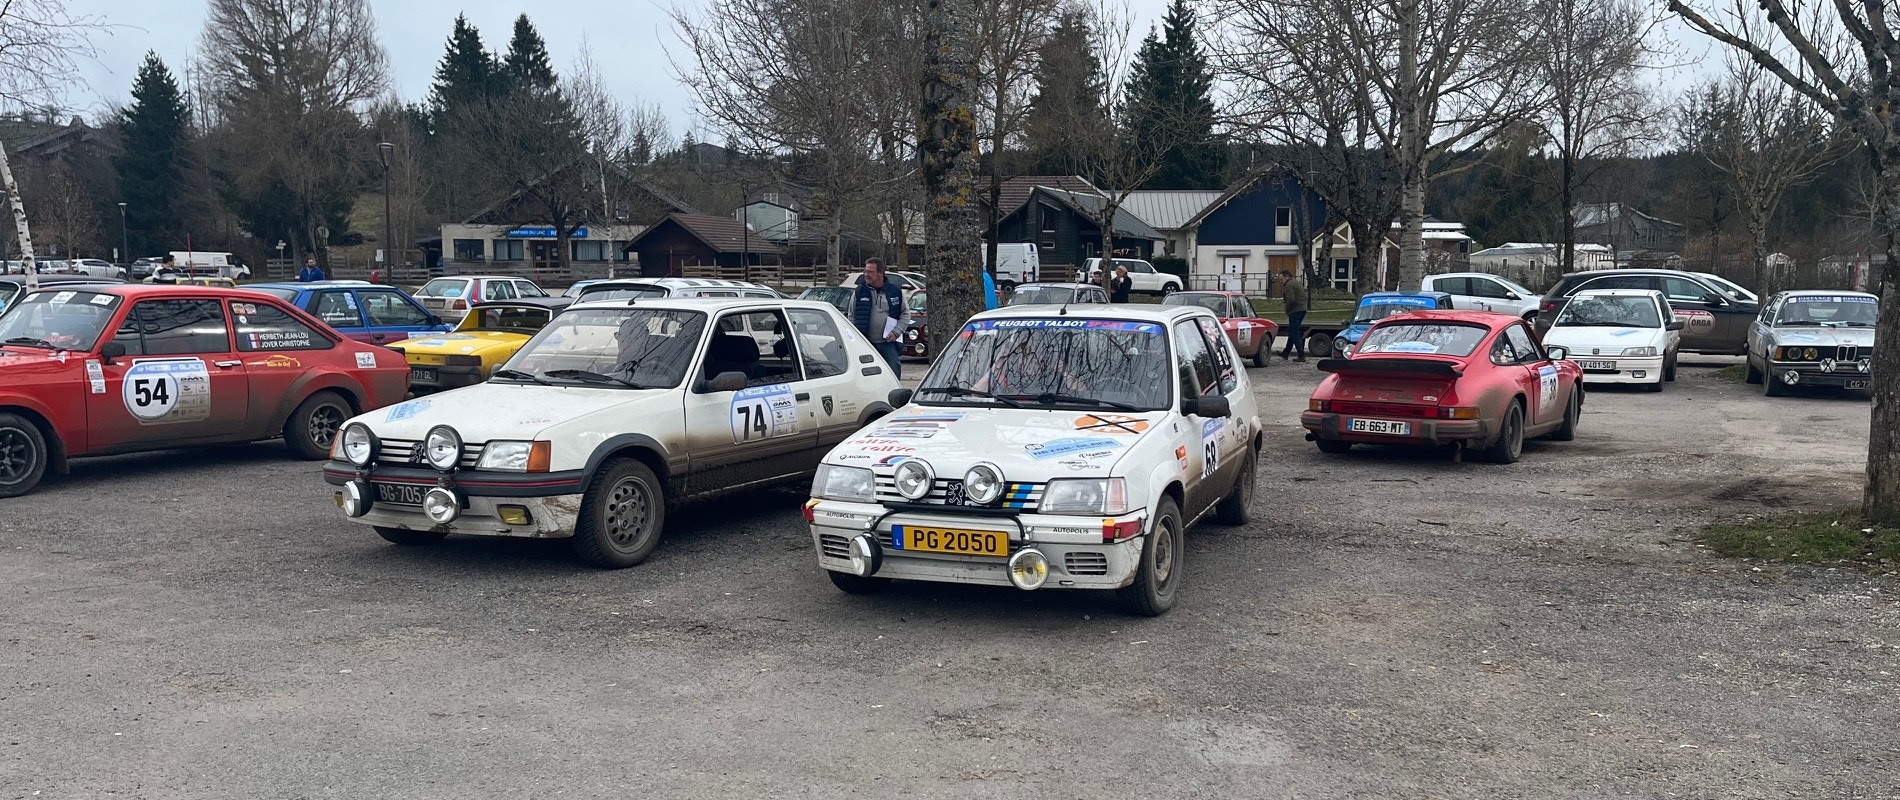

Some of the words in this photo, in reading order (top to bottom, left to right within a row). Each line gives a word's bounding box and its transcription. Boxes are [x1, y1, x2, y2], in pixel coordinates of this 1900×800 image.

[134, 378, 169, 407] 54
[737, 404, 767, 440] 74
[1354, 421, 1403, 433] EB-663-MT
[913, 530, 938, 548] PG
[944, 532, 997, 552] 2050
